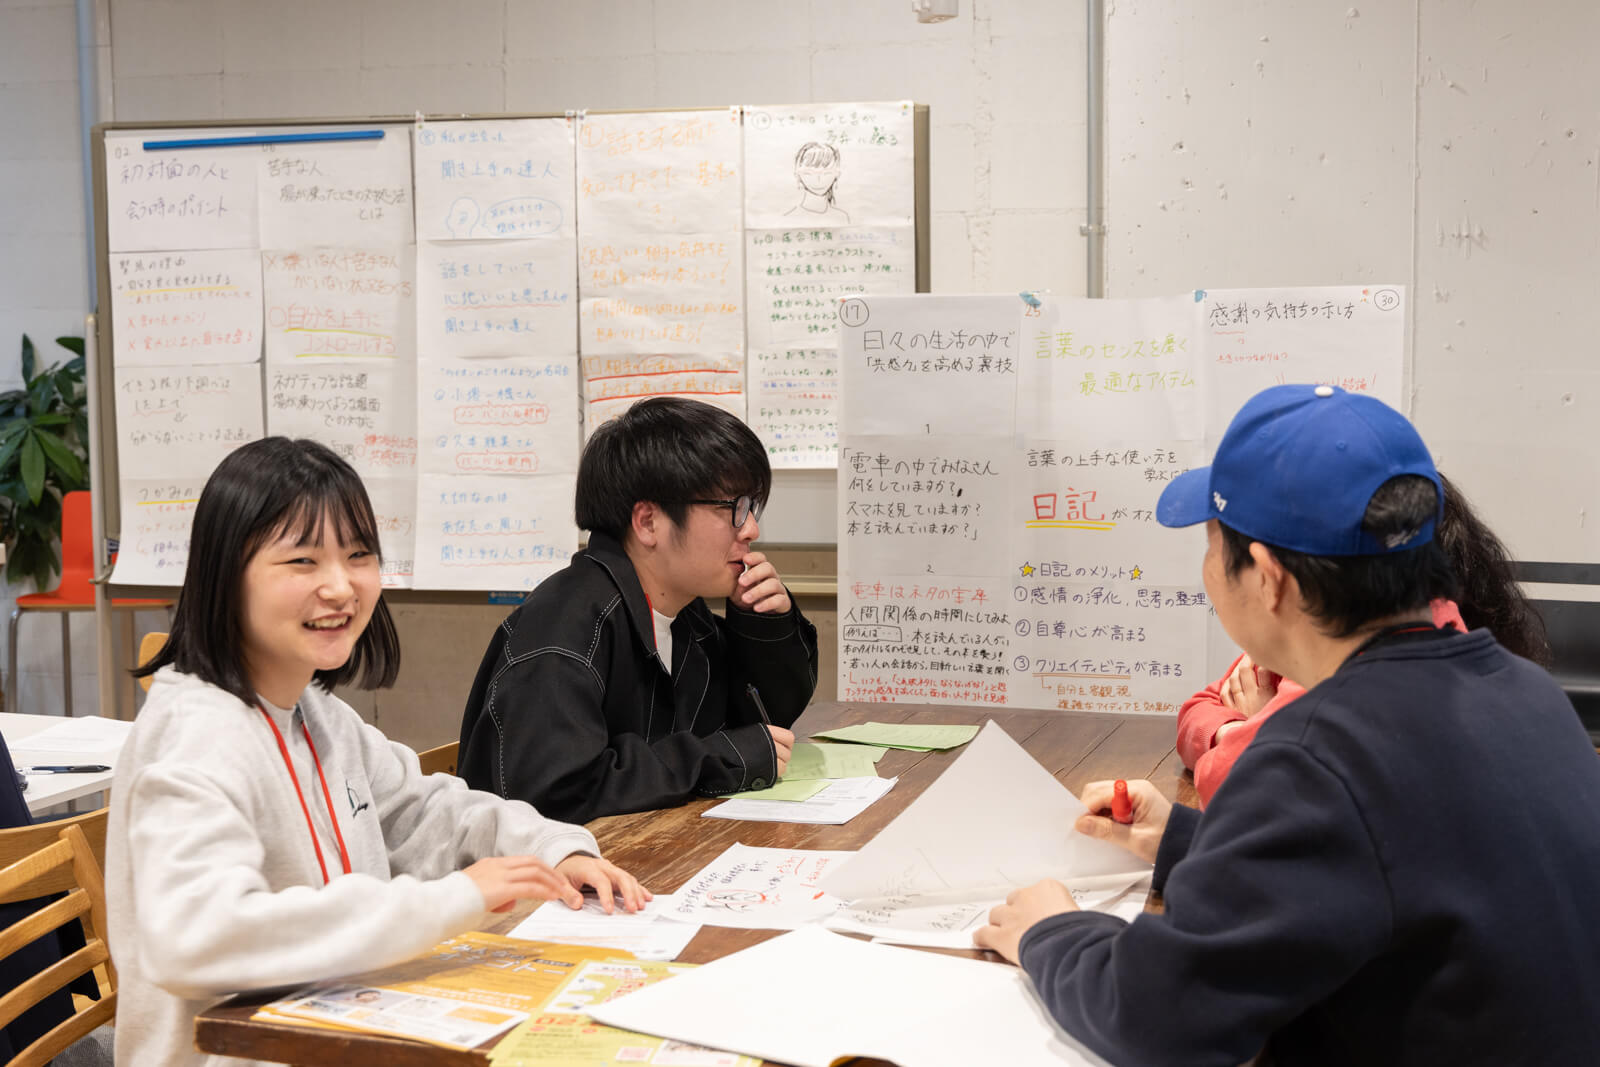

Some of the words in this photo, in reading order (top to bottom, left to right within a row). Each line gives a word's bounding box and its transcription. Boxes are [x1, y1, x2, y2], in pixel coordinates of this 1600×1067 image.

[120, 158, 229, 184] 初対面の人と
[267, 158, 324, 177] 苦手な人
[441, 160, 559, 180] 聞き上手の達人
[126, 193, 230, 220] 会う時のポイント
[1210, 301, 1356, 328] 感謝の気持ちの示し方
[863, 330, 1016, 351] 日々の生活の中で
[1034, 331, 1188, 359] 言葉のセンスを磨く
[866, 353, 1016, 374] 「共感力」を高める裏技
[1079, 370, 1196, 397] 最適なアイテム
[843, 447, 1000, 478] 「電車の中でみなさん
[1026, 449, 1177, 467] 言葉の上手な使い方を
[848, 478, 956, 494] 何をしていますか?
[846, 501, 982, 518] スマホを見ていますか?
[1033, 487, 1105, 521] 日記
[846, 521, 979, 541] 本を読んでいますか?」
[926, 564, 935, 574] 2
[1040, 561, 1126, 579] 日記のメリット
